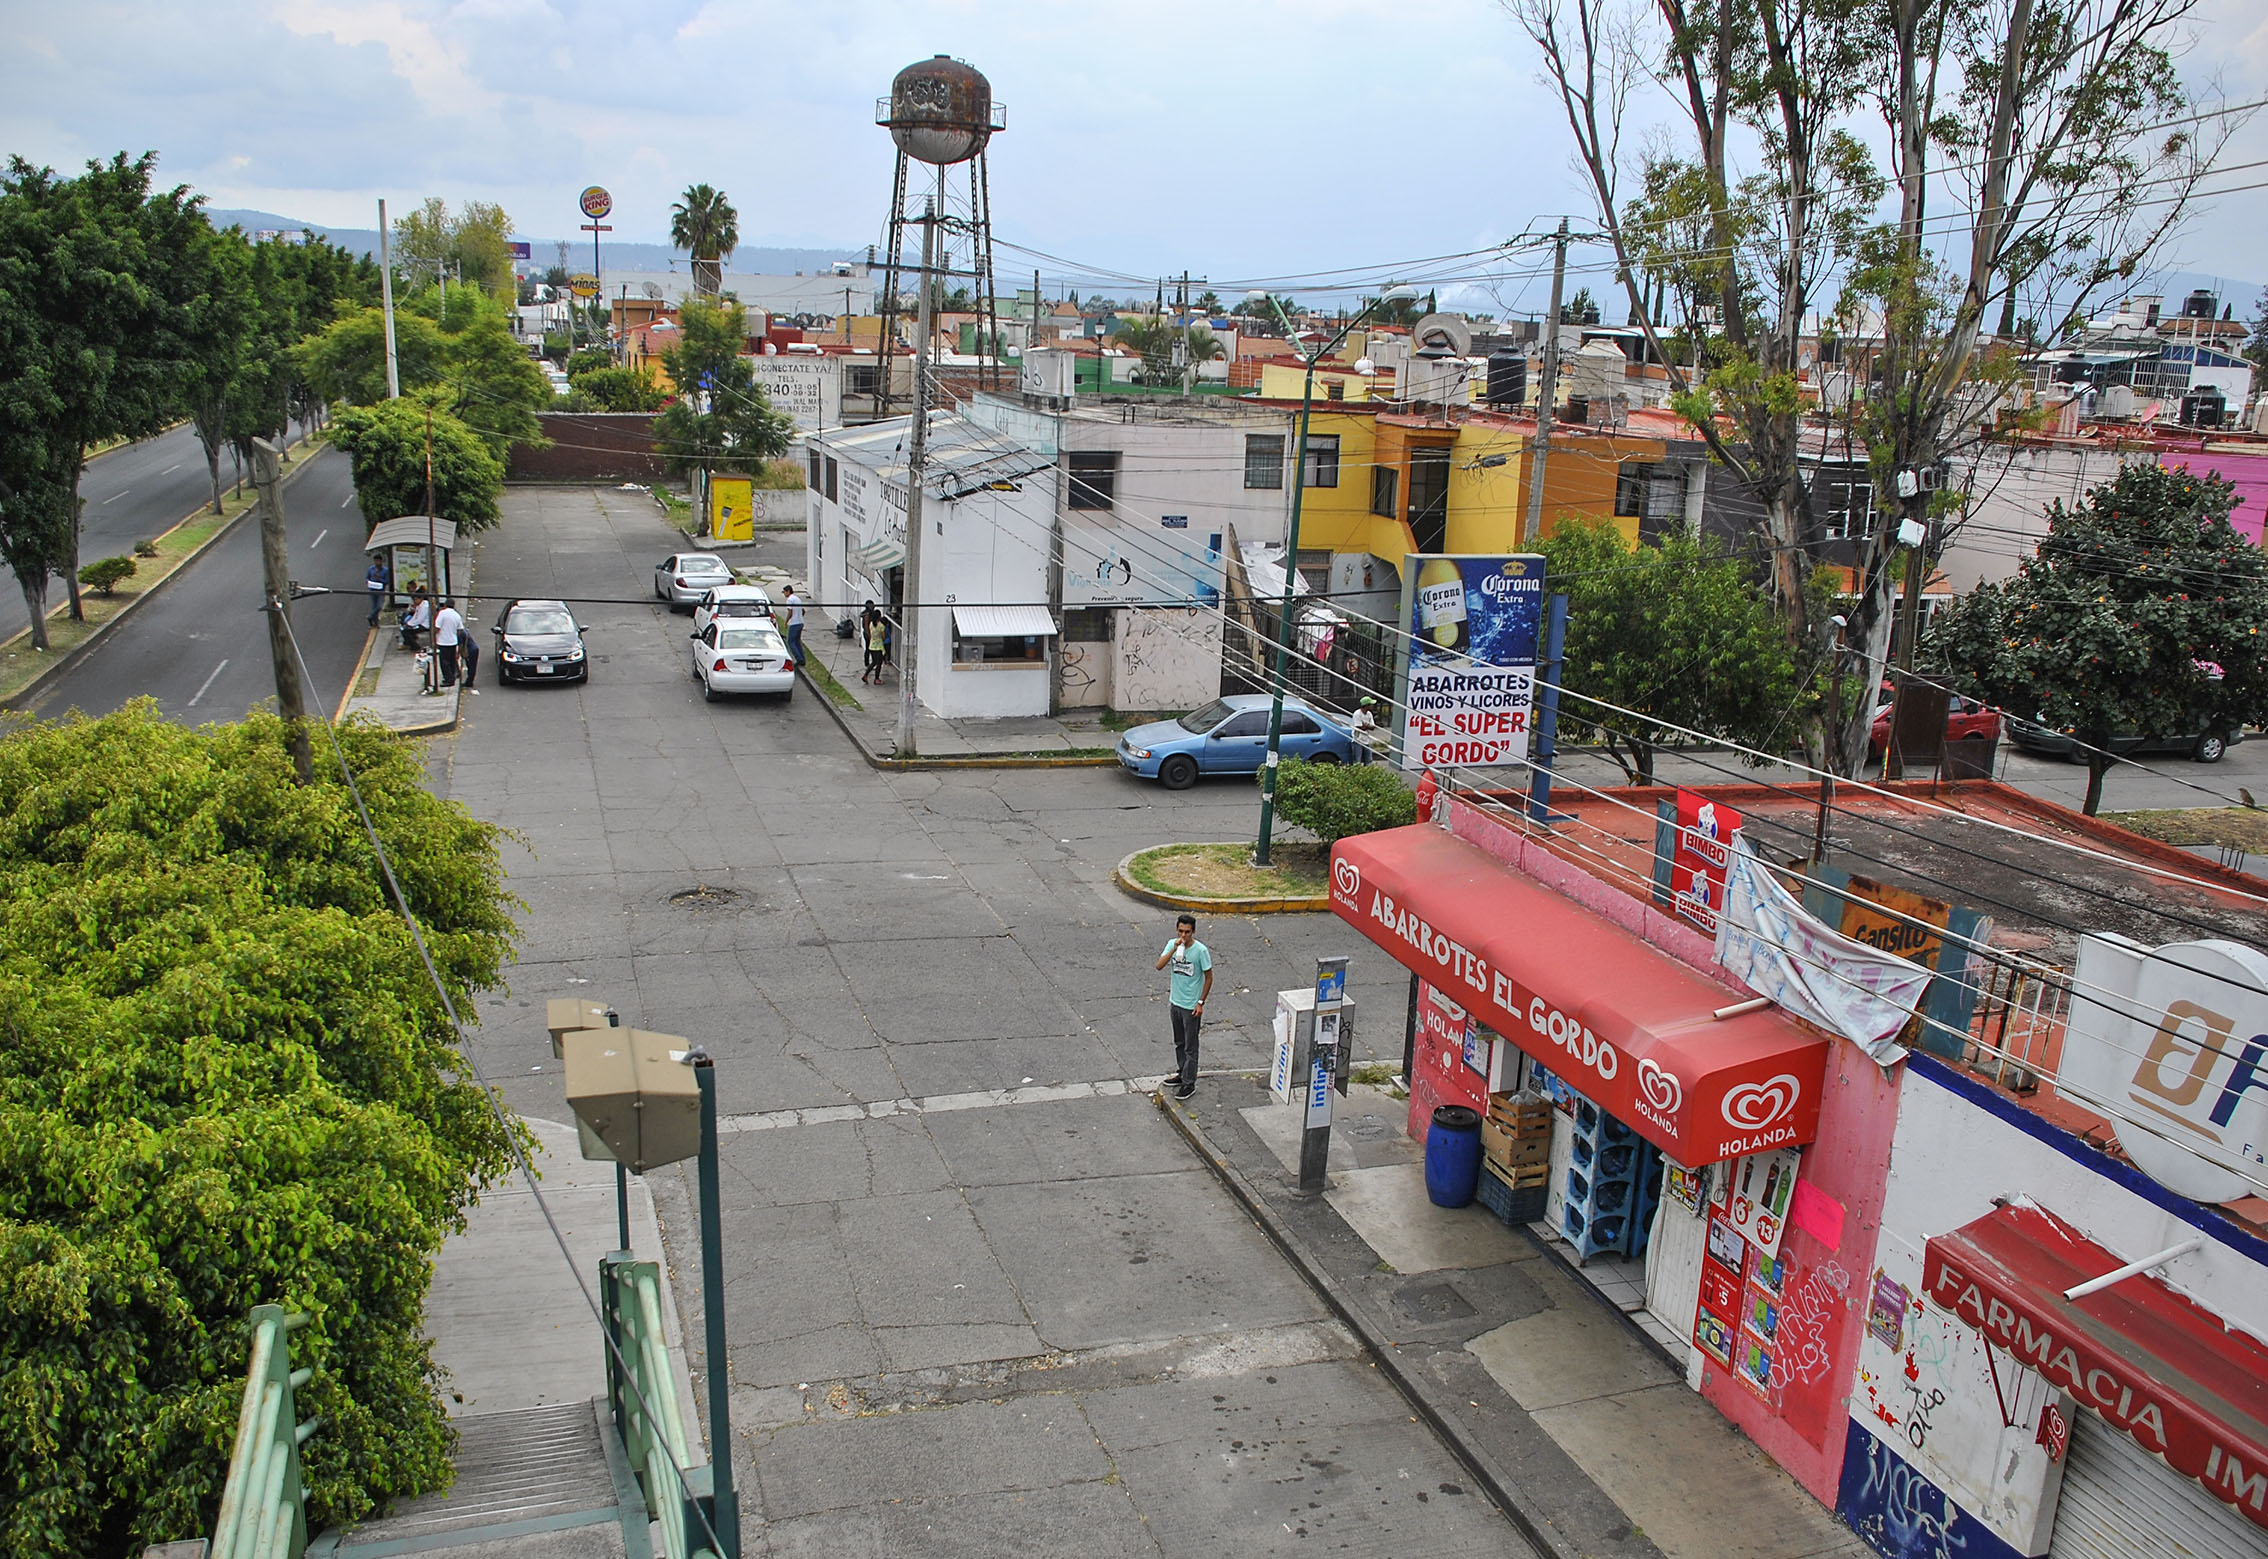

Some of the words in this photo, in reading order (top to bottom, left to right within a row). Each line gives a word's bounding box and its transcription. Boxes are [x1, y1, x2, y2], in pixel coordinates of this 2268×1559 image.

[583, 192, 608, 203] BURGER
[584, 199, 609, 211] KING
[763, 383, 790, 396] 340
[1422, 586, 1461, 605] Corona
[1481, 573, 1540, 598] Corona
[945, 594, 957, 603] 23
[1433, 601, 1457, 611] Extra
[1497, 592, 1524, 604] Extra
[1412, 674, 1530, 693] ABARROTES
[1411, 696, 1454, 709] VINOS
[1458, 695, 1468, 708] Y
[1471, 693, 1529, 708] LICORES
[1454, 712, 1525, 734] SUPER
[1686, 833, 1726, 864] BIMBO
[1333, 888, 1359, 913] HOLANDA
[1679, 898, 1717, 930] BIMBO
[1371, 889, 1487, 992] ABARROTES
[1493, 970, 1522, 1020] EL
[1529, 996, 1618, 1080] GORDO
[1634, 1098, 1679, 1140] HOLANDA
[1719, 1126, 1797, 1157] HOLANDA
[1936, 1262, 2169, 1448] FARMACIA
